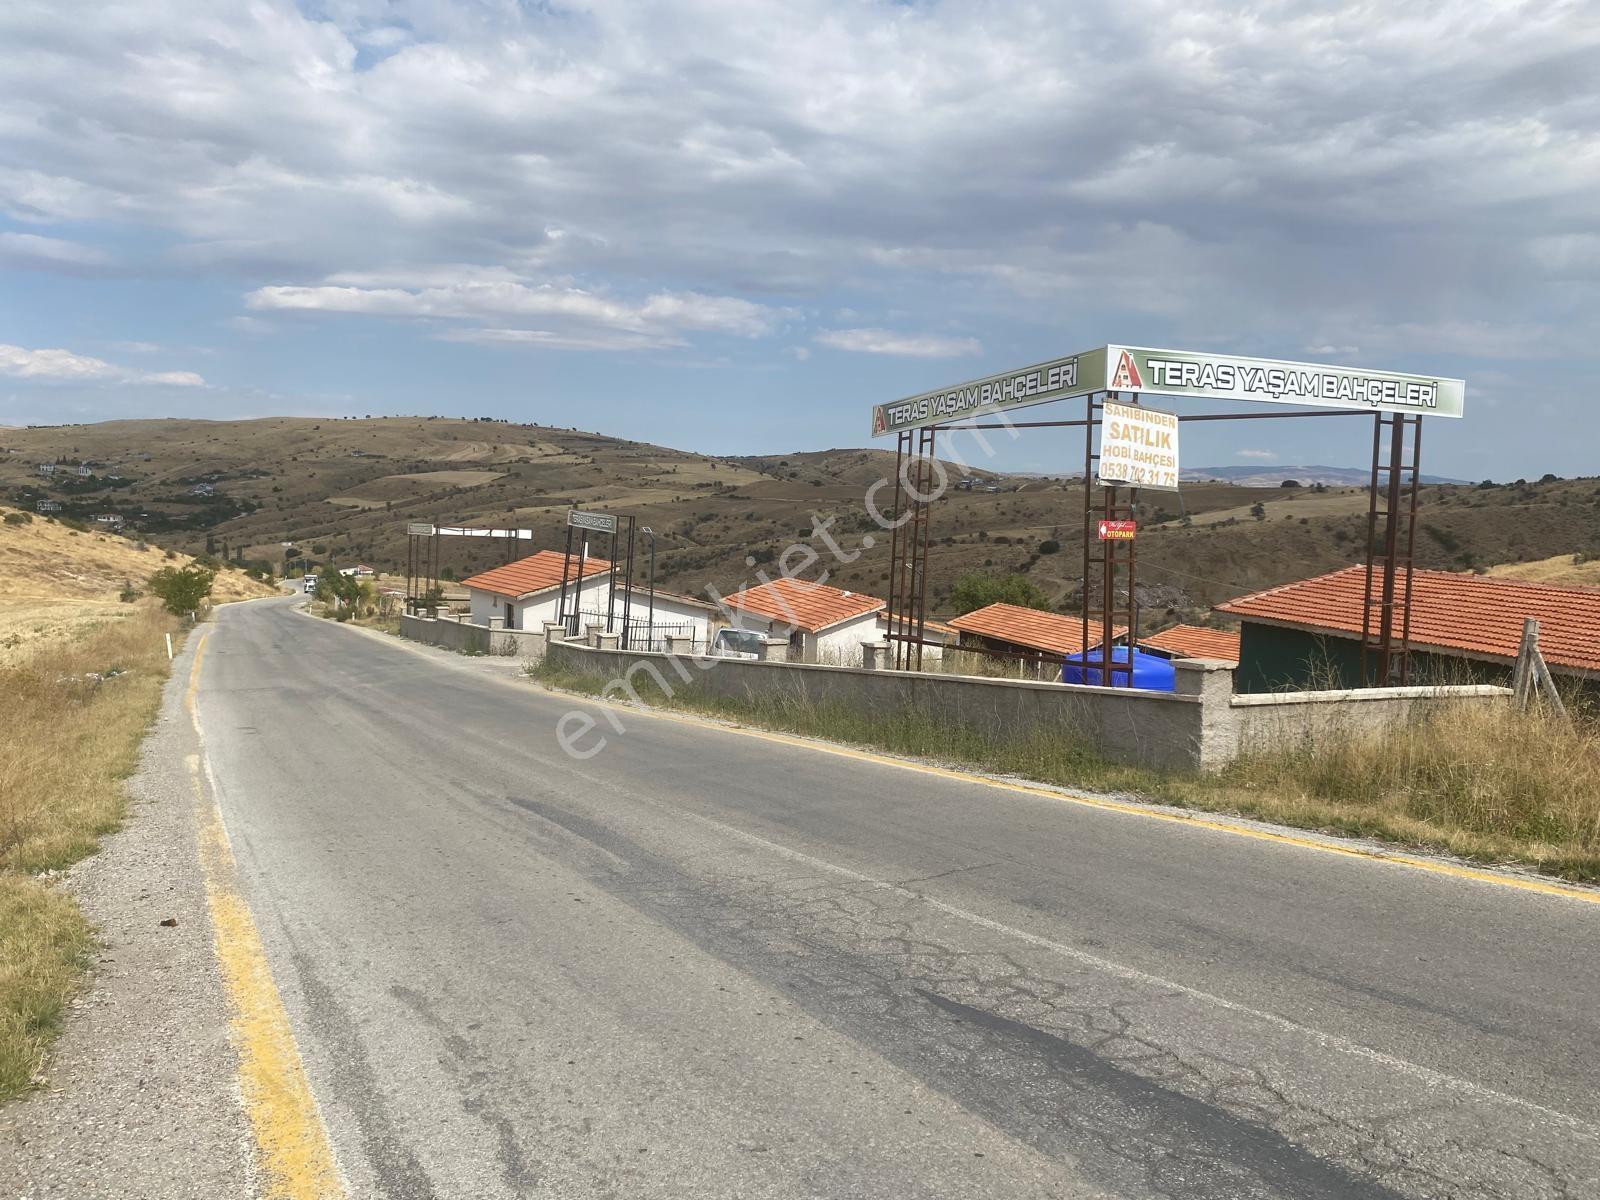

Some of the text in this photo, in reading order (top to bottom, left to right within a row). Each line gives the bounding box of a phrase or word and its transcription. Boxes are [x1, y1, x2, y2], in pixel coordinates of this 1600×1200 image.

[887, 356, 1078, 426] TERAS YAŞAM BAHÇELERİ
[1147, 359, 1438, 408] TERAS YAŞAM BAHÇELERİ
[1109, 421, 1172, 450] SATILIK
[1101, 462, 1176, 487] 0538 702 31 75
[1107, 530, 1134, 538] OTOPARK
